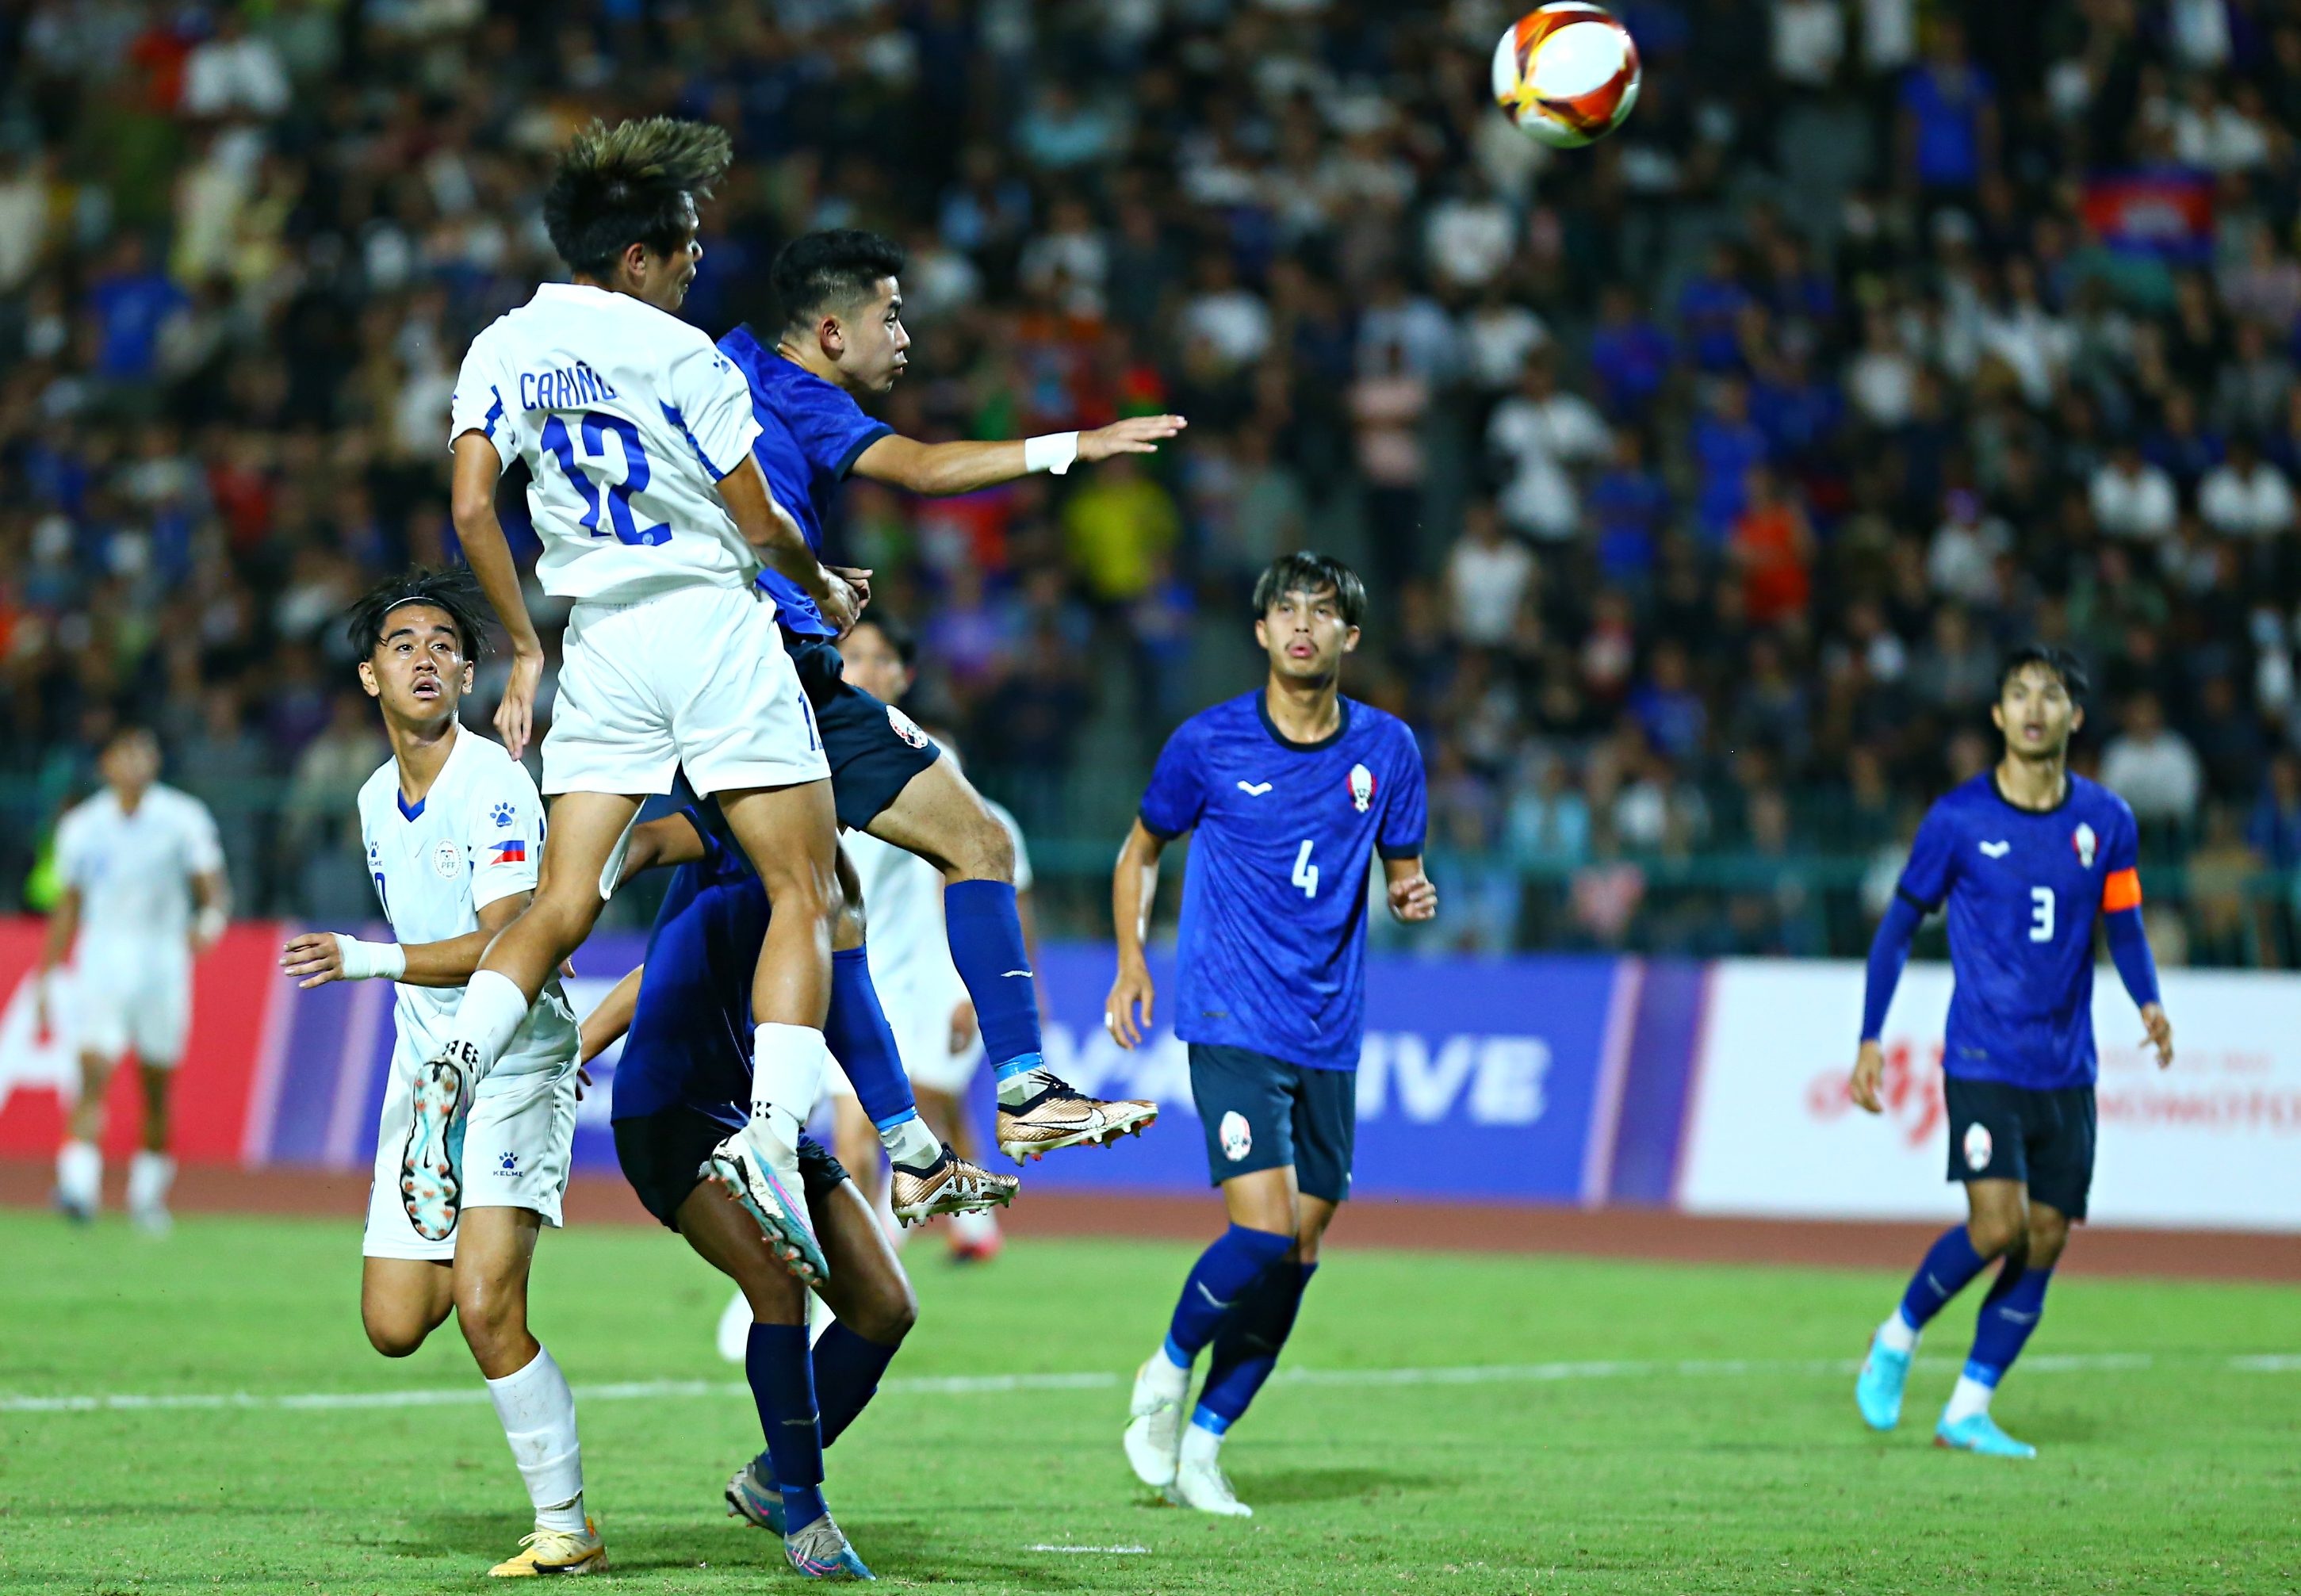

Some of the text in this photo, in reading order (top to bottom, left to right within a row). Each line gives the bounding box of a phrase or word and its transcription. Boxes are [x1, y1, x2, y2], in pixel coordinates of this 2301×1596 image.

[541, 411, 672, 546] 12
[1292, 839, 1319, 898] 4
[2029, 886, 2055, 943] 3
